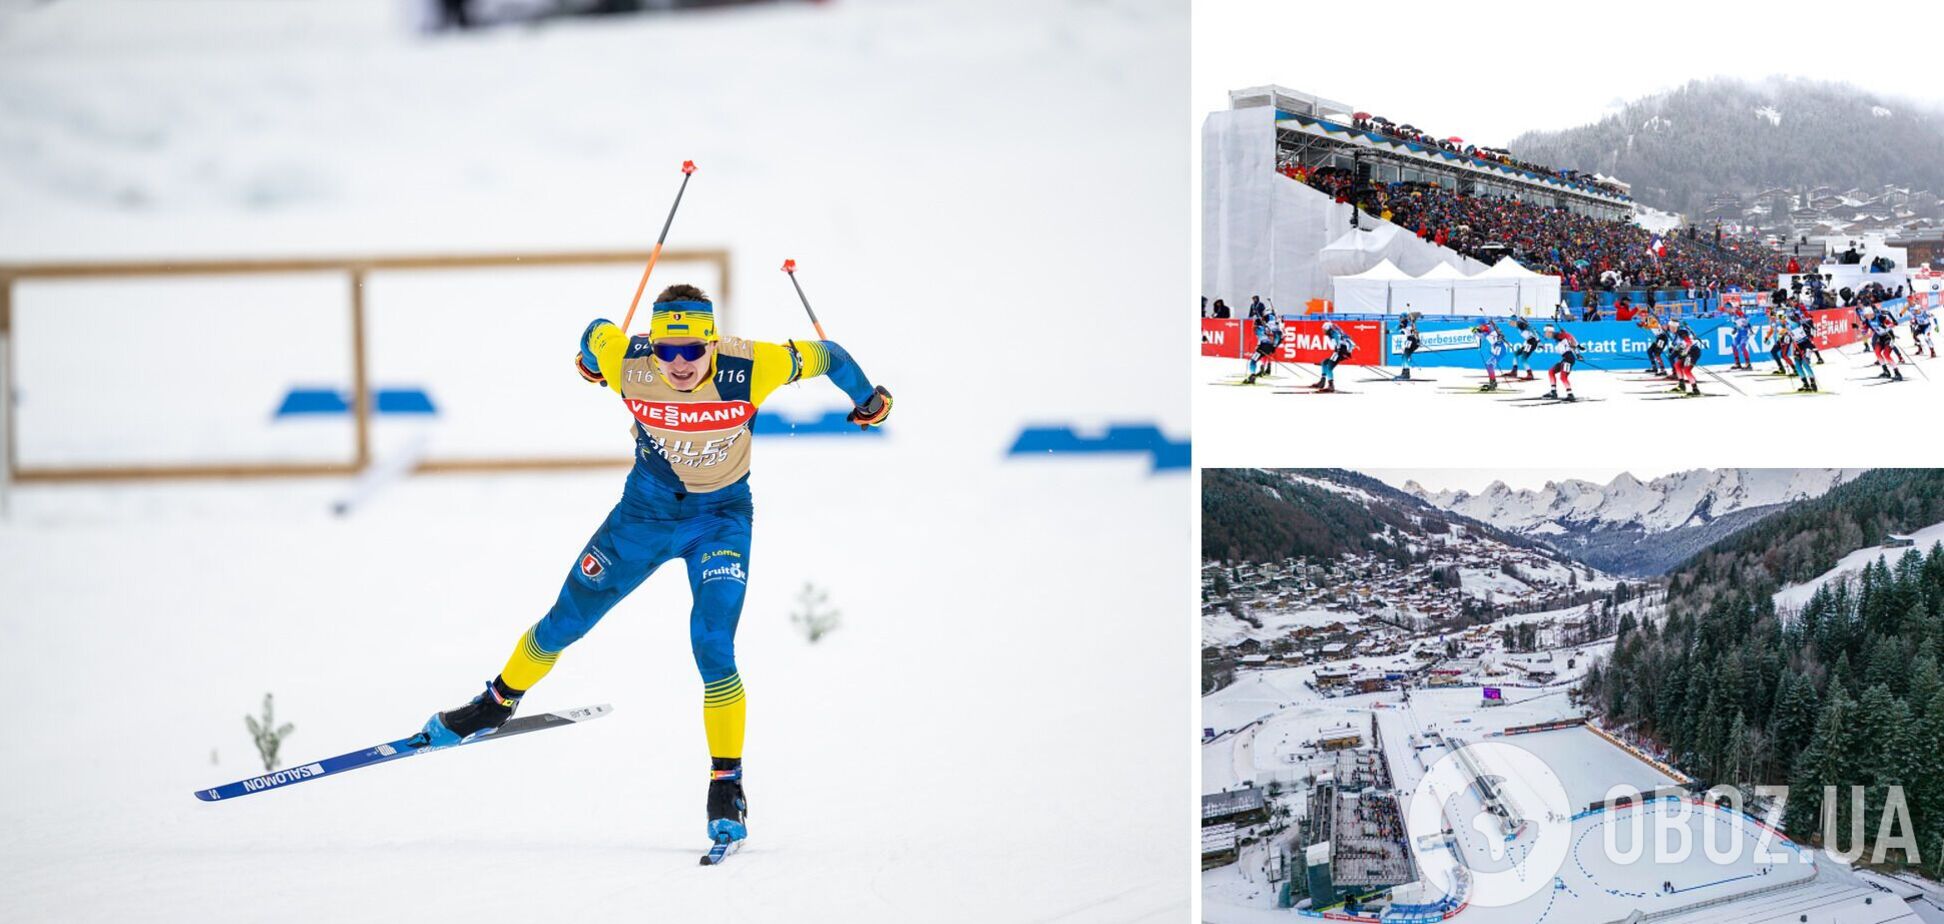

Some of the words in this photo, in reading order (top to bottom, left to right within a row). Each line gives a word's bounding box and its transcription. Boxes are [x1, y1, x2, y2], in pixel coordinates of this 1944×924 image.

[626, 369, 654, 383] 116
[717, 369, 746, 384] 116
[631, 400, 746, 427] VIESSMANN
[243, 765, 314, 793] SALOMON
